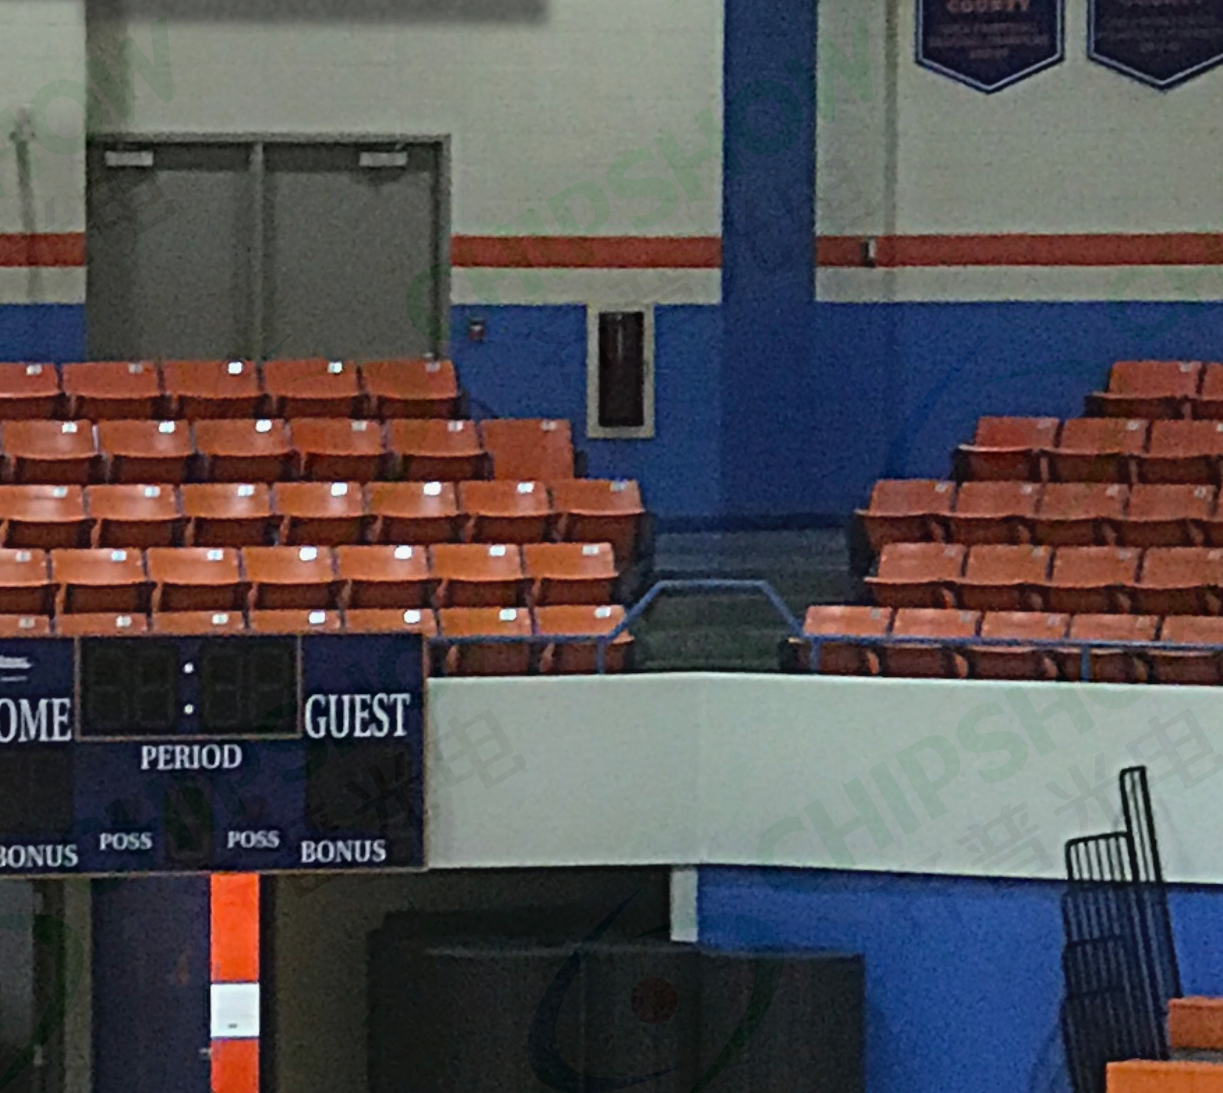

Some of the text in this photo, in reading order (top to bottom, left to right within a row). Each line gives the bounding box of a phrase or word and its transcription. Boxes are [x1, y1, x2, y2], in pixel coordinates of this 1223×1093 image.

[304, 693, 411, 739] GUEST
[140, 744, 243, 770] PERIOD
[99, 832, 153, 851] POSS
[227, 830, 281, 849] POSS
[300, 839, 387, 863] BONUS
